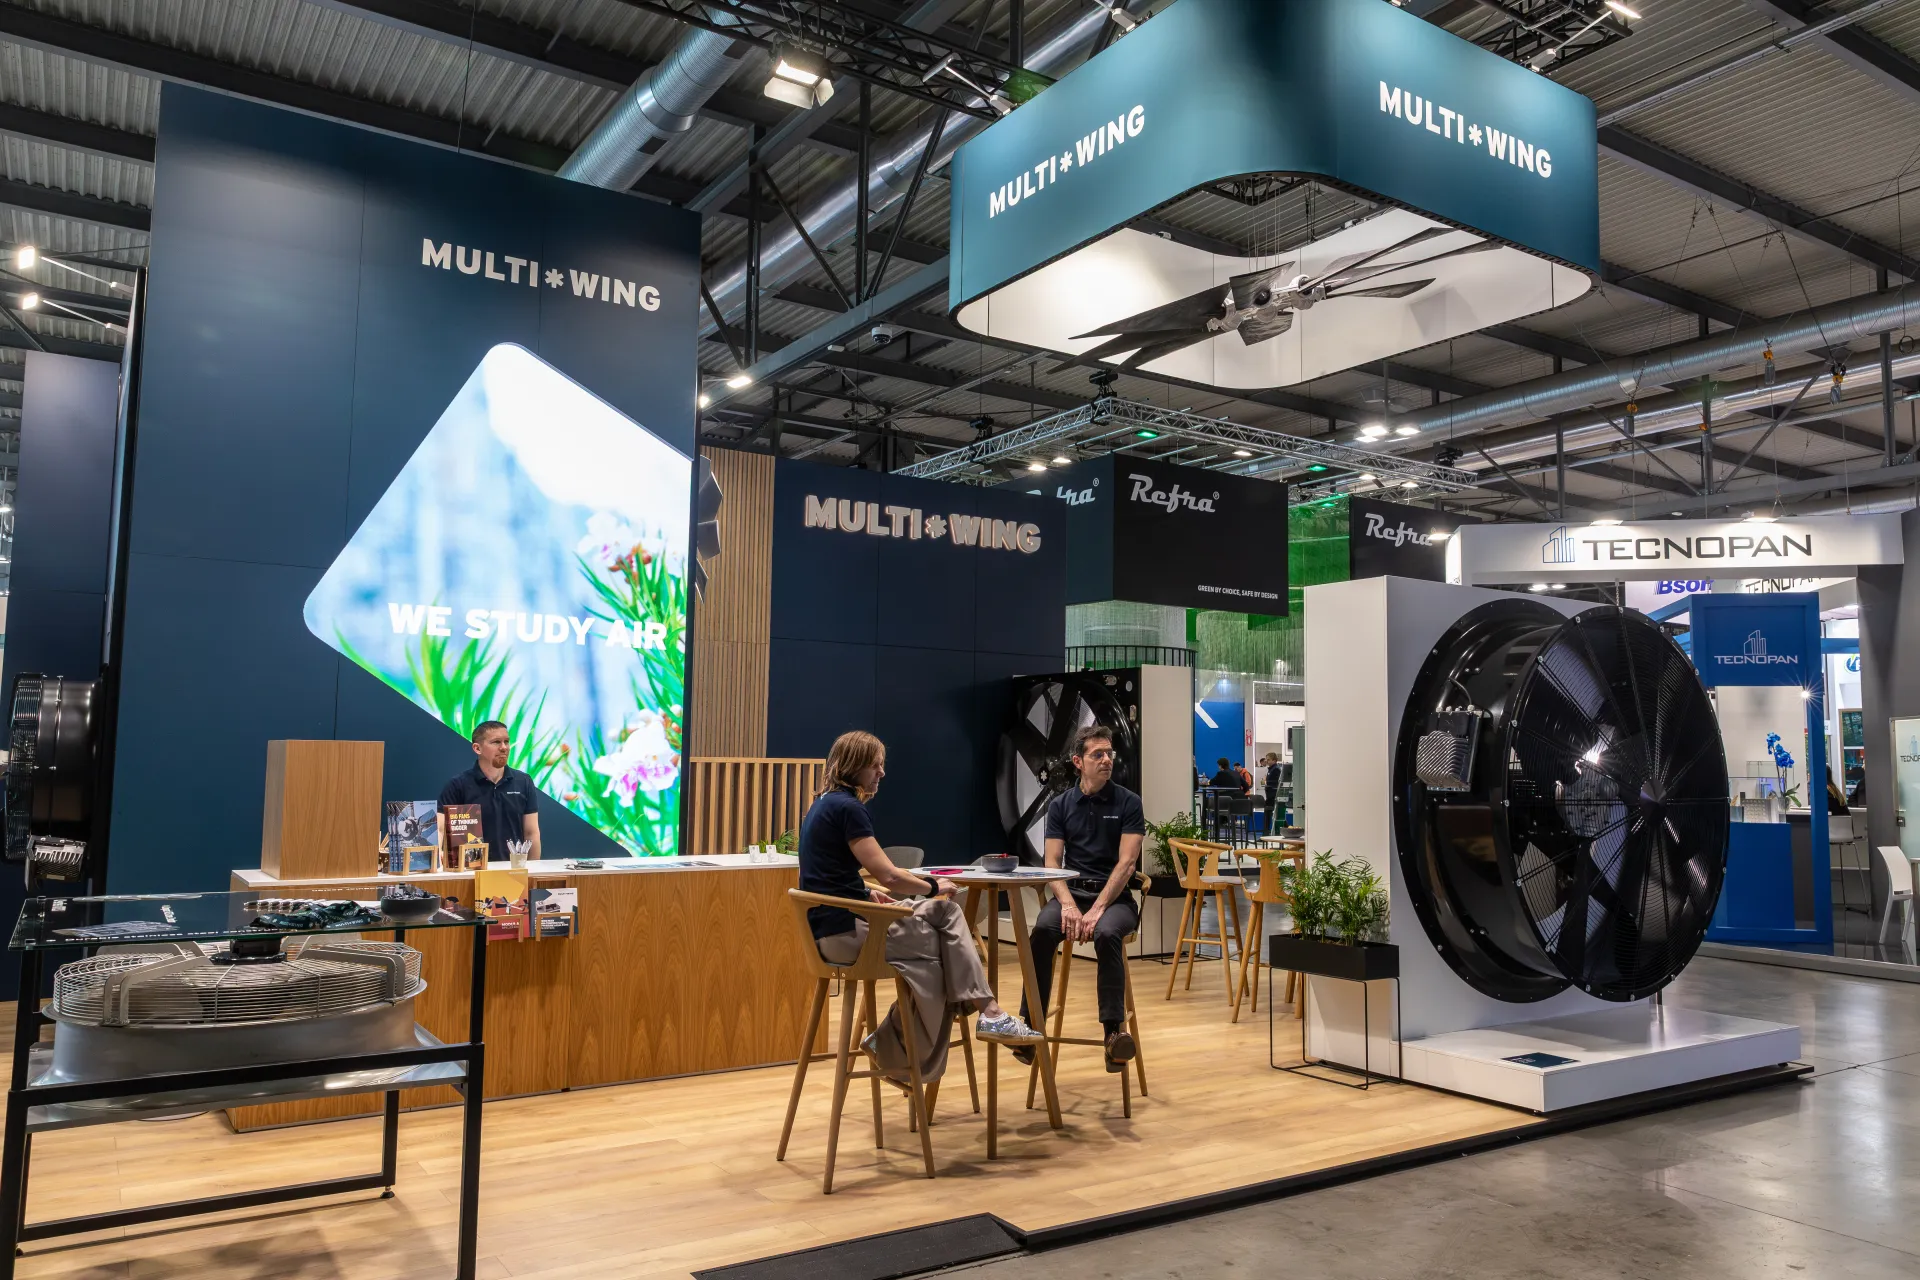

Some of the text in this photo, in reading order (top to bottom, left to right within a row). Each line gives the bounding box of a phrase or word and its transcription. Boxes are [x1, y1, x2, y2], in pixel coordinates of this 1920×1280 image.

[1582, 534, 1812, 561] TECNOPAN
[1197, 584, 1215, 593] GREEN
[1222, 587, 1241, 596] CHOICE,
[1242, 589, 1253, 597] SAFE
[388, 602, 667, 650] WE STUDY AIR
[1713, 655, 1799, 664] TECNOPAN
